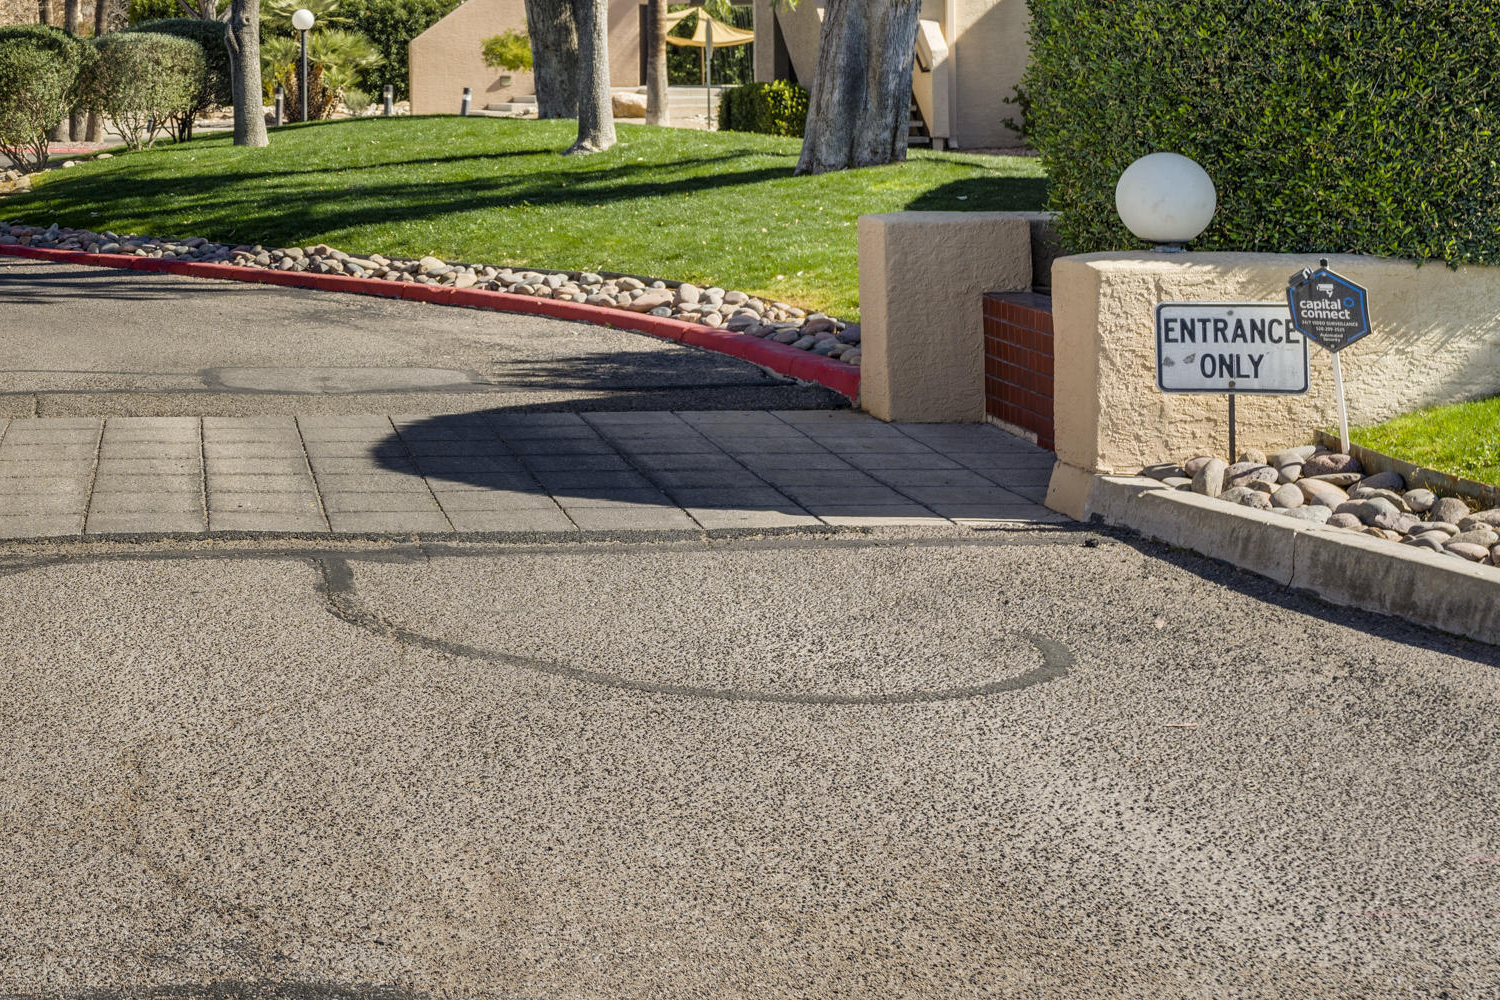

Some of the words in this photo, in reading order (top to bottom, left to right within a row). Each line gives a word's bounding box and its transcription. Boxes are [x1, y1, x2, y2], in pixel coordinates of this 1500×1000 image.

[1300, 299, 1341, 310] capital
[1301, 309, 1350, 319] connect
[1163, 318, 1300, 344] ENTRANCE
[1200, 353, 1264, 379] ONLY
